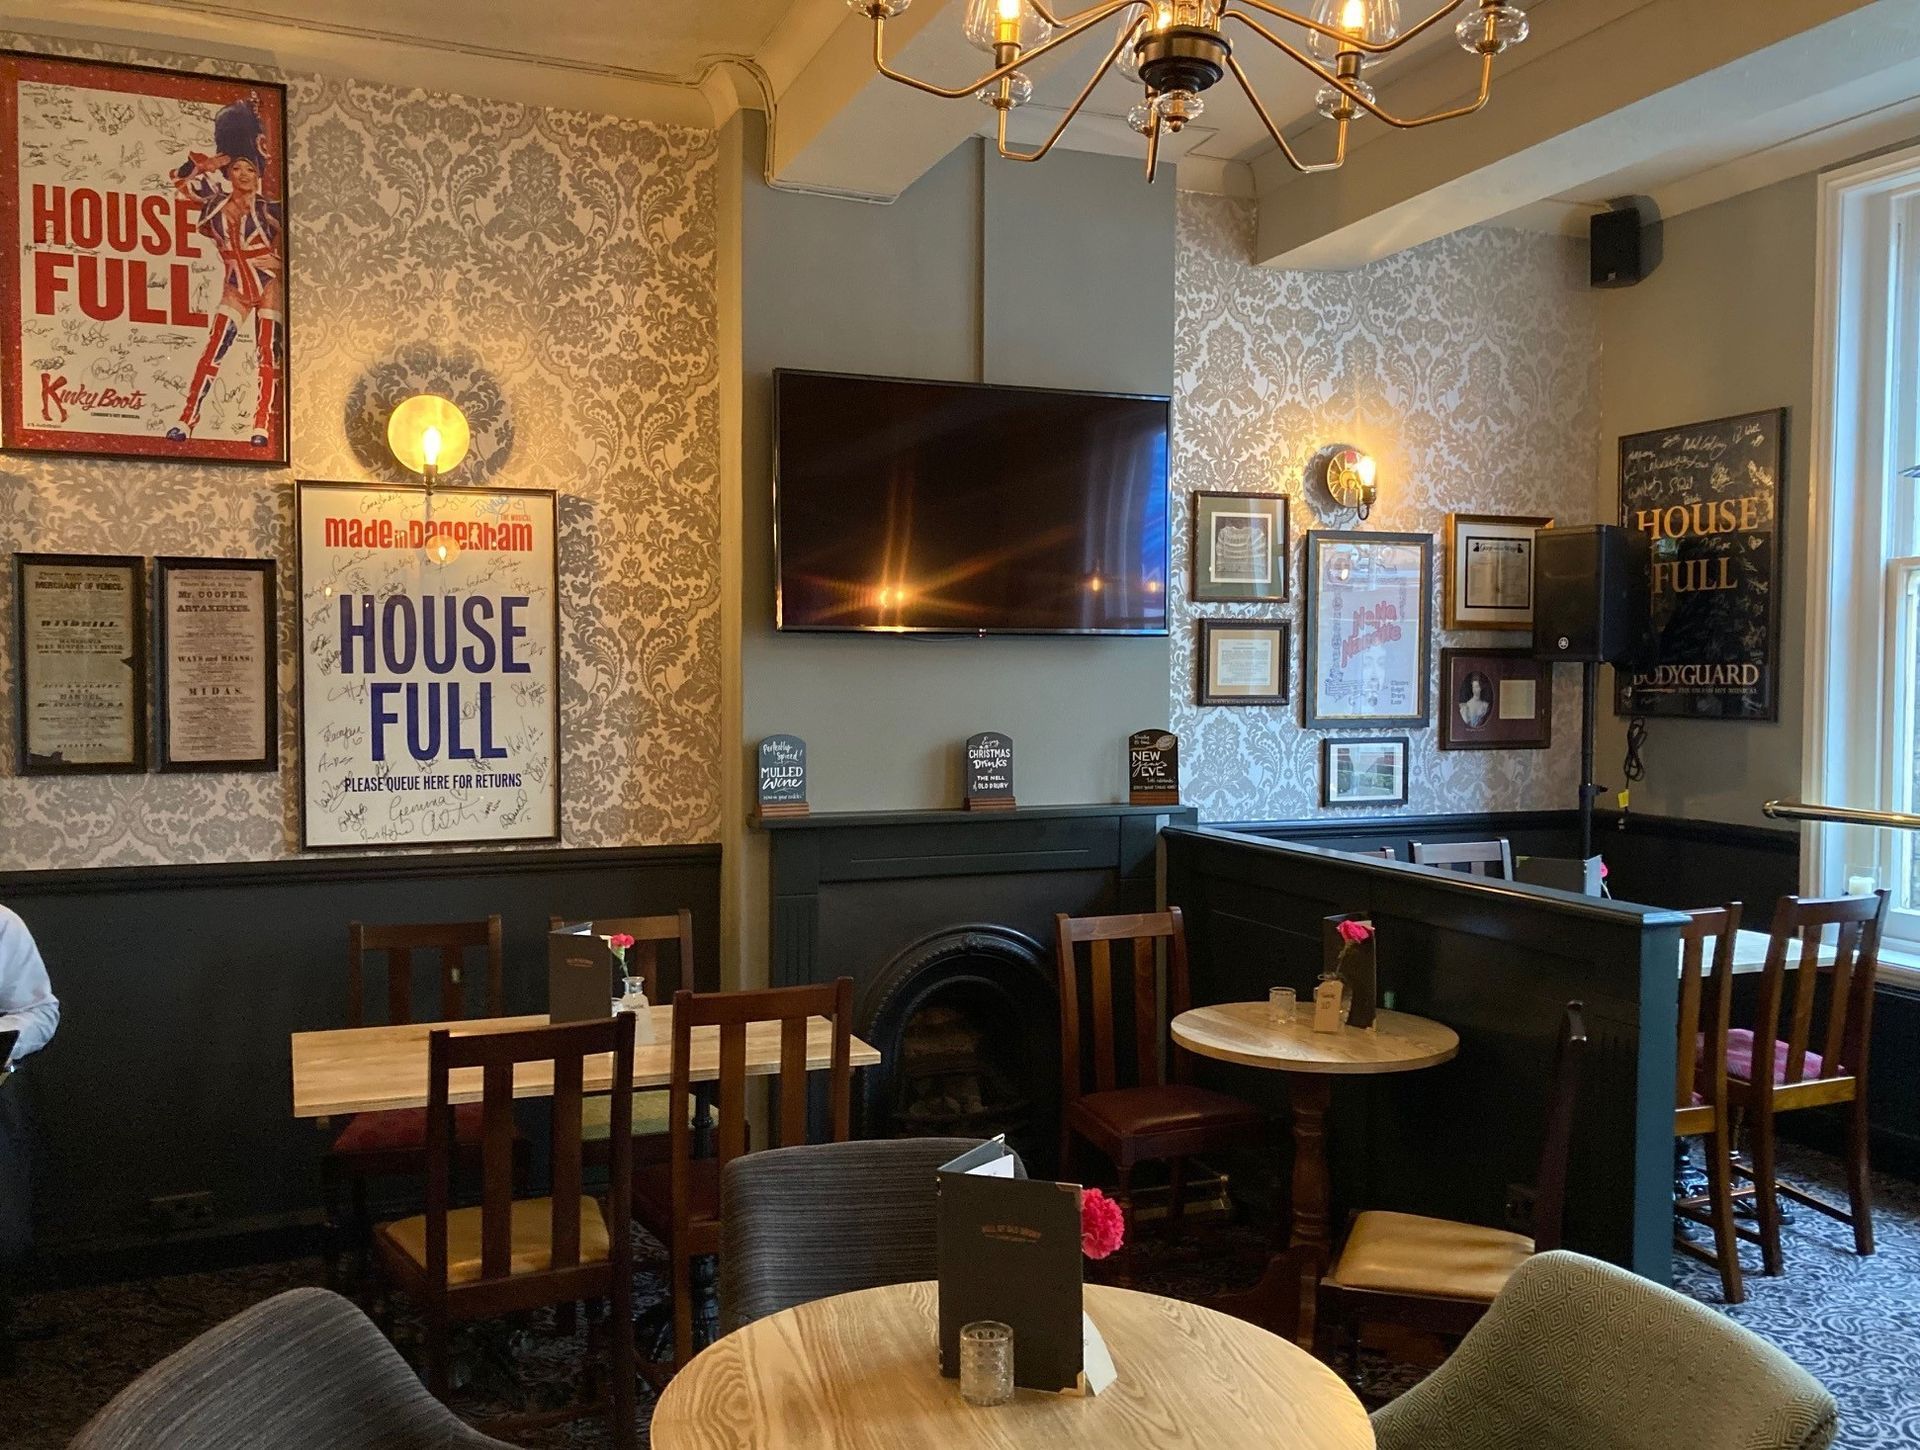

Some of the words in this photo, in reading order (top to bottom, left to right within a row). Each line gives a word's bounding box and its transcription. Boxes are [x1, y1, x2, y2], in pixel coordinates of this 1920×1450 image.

[32, 184, 202, 259] HOUSE
[34, 251, 209, 328] FULL
[41, 372, 99, 422] Kinky
[97, 388, 147, 410] Boots
[325, 517, 393, 549] made
[394, 528, 408, 549] in
[409, 519, 533, 552] Dagenham
[1636, 496, 1759, 541] HOUSE
[1653, 556, 1739, 595] FULL
[339, 594, 531, 674] HOUSE
[370, 682, 508, 762] FULL
[761, 766, 804, 778] MULLED
[968, 748, 1011, 759] CHRISTMAS
[1132, 751, 1161, 761] NEW
[1141, 766, 1165, 776] EVE
[344, 776, 384, 792] PLEASE
[387, 775, 419, 791] QUEUE
[423, 775, 450, 790] HERE
[453, 774, 473, 789] FOR
[476, 773, 522, 789] RETURNS
